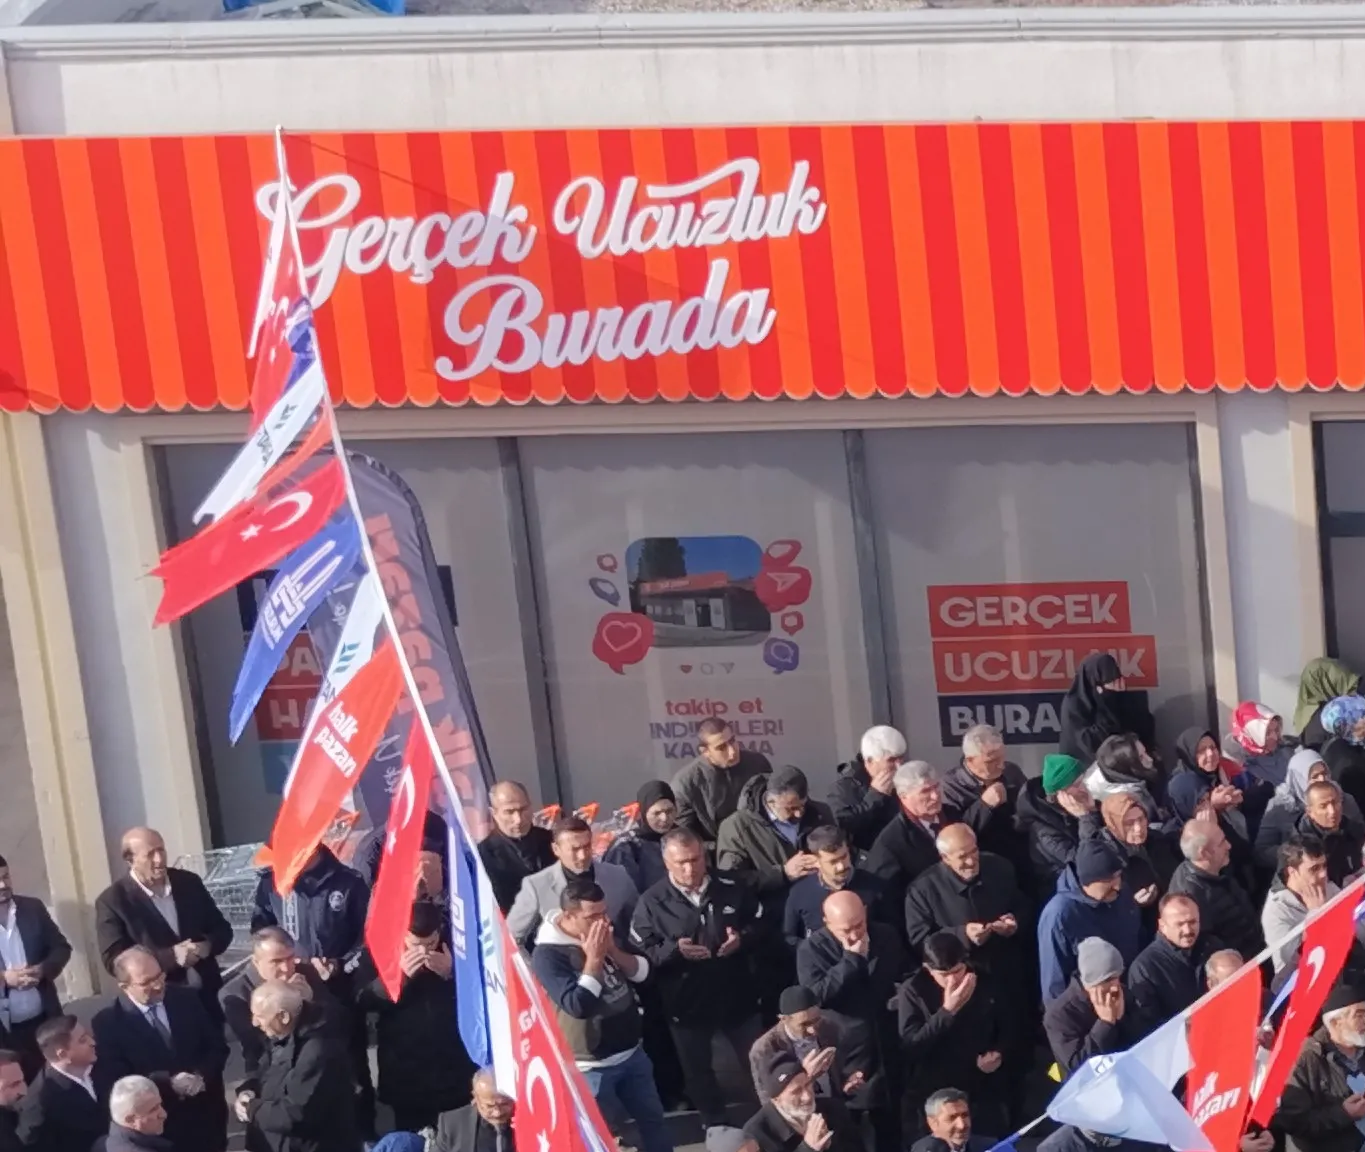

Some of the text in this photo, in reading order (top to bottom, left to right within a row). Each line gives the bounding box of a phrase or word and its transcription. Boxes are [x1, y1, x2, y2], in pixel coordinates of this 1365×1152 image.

[256, 157, 826, 308] Gerçek Ucuzluk
[435, 259, 776, 381] Burada
[940, 593, 1118, 629] GERÇEK
[944, 649, 1146, 682] UCUZLK
[665, 697, 763, 717] takip et
[948, 703, 1061, 736] BURA
